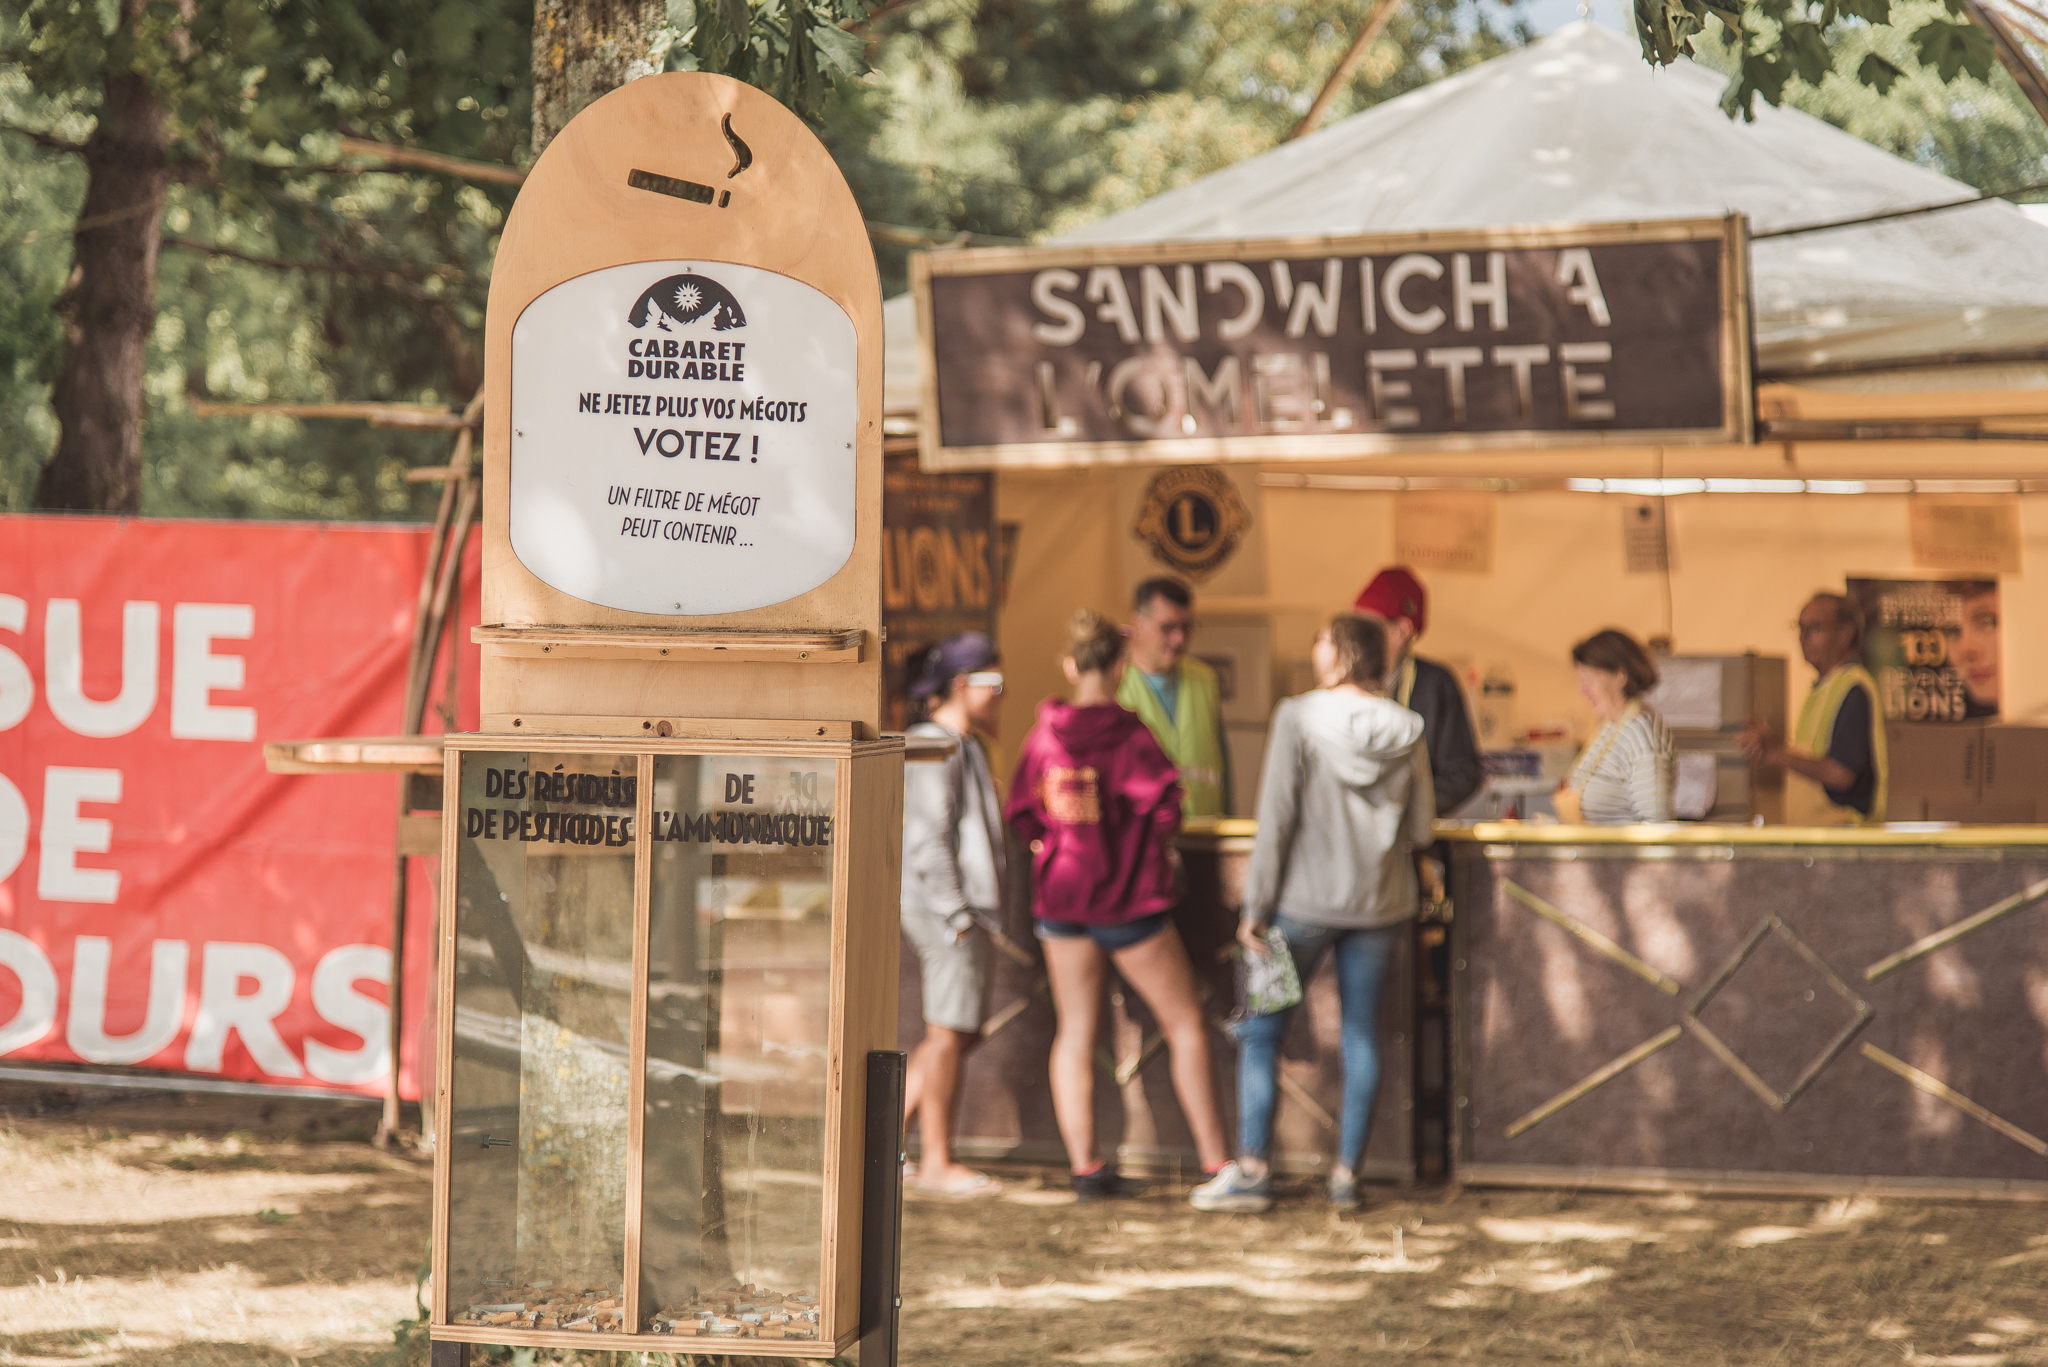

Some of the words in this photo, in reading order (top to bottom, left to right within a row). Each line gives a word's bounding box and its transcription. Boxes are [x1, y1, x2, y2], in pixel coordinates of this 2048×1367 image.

[1030, 250, 1509, 347] SANDWICH
[1553, 246, 1612, 328] A
[628, 338, 746, 362] CABARET
[627, 360, 745, 382] DURABLE
[1032, 341, 1616, 438] L'OMELETTE
[578, 392, 601, 414] NE
[604, 393, 652, 416] JETEZ
[655, 395, 699, 418] PLUS
[701, 397, 736, 420] VOS
[739, 395, 808, 423] MÉGOTS
[633, 427, 742, 462] VOTEZ
[751, 435, 759, 464] !
[607, 485, 632, 506] UN
[633, 487, 682, 511] FILTRE
[684, 491, 706, 512] DE
[707, 489, 761, 517] MÉGOT
[620, 516, 661, 539] PEUT
[663, 521, 737, 546] CONTENIR
[486, 768, 529, 799] DES
[725, 773, 754, 804] DE
[0, 764, 122, 904] E
[467, 808, 497, 839] DE
[503, 810, 632, 847] PESTICIDES
[653, 811, 831, 847] L'AMMONIAQUE
